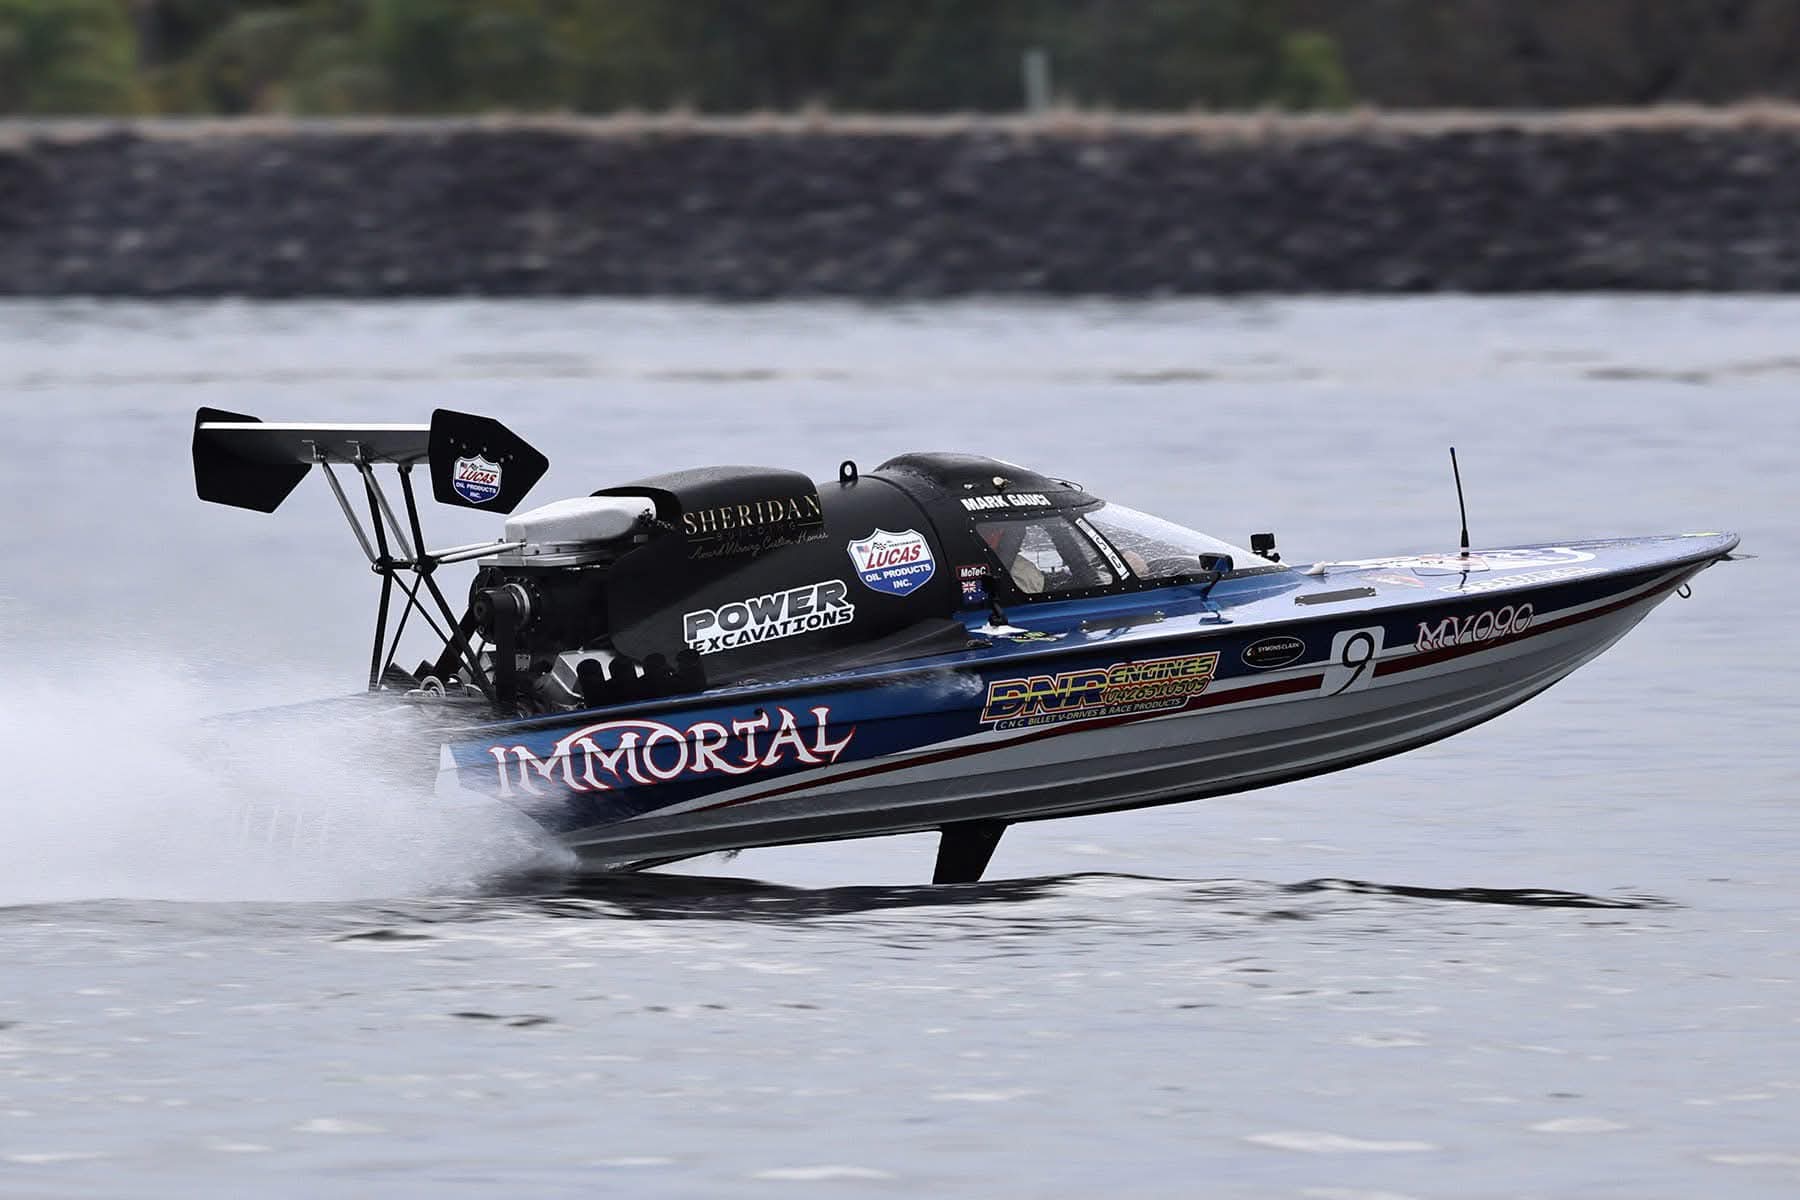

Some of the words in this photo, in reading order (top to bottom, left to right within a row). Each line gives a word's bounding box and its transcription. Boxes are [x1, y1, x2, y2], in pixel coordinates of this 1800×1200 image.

[459, 470, 497, 484] LUCAS
[683, 494, 820, 535] SHERIDAN
[960, 495, 1010, 511] MARK
[1007, 494, 1052, 507] GAUCI
[866, 544, 921, 570] LUCAS
[865, 574, 881, 583] OIL
[883, 563, 931, 579] PRODUCTS
[893, 579, 912, 589] INC.
[685, 580, 848, 642] POWER
[691, 606, 852, 654] EXCAVATIONS
[1108, 656, 1216, 684] ENGINES
[1327, 631, 1375, 697] 9
[1028, 713, 1056, 725] BILLET
[1058, 709, 1099, 721] V-DRIVES
[1100, 707, 1107, 716] &
[1109, 704, 1133, 714] RACE
[1133, 699, 1181, 711] PRODUCTS
[488, 706, 857, 797] IMMORTAL
